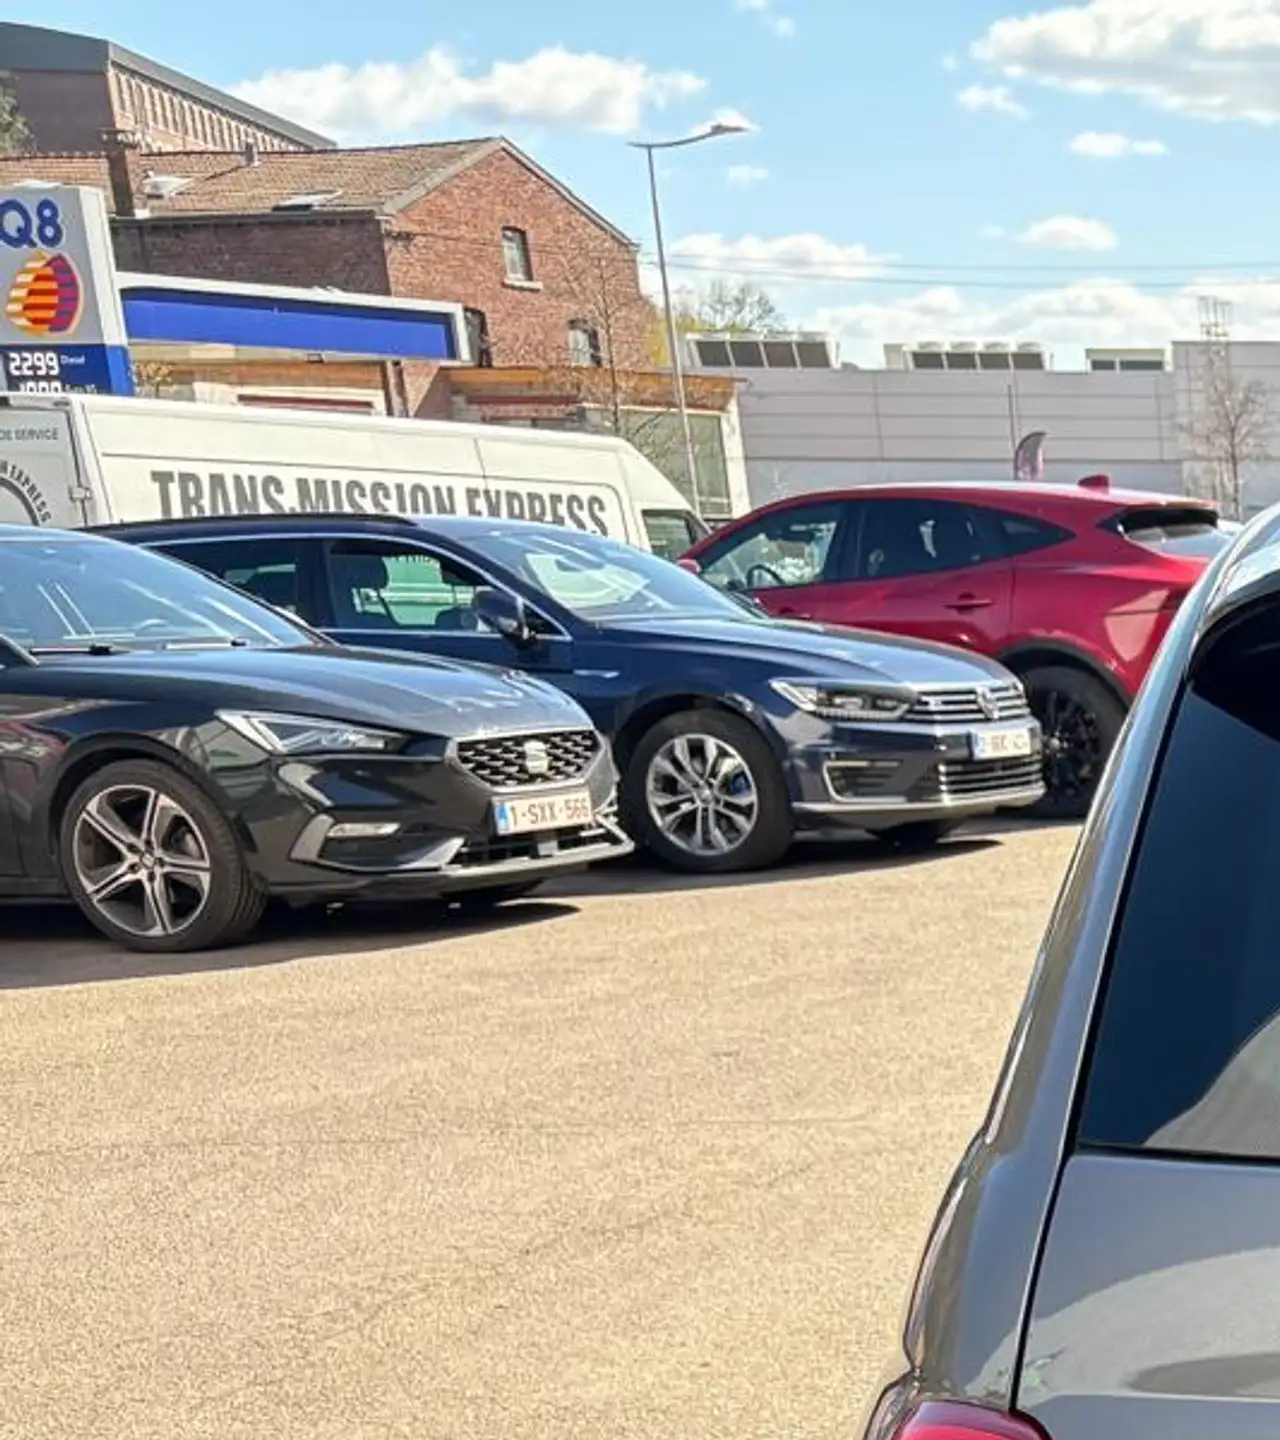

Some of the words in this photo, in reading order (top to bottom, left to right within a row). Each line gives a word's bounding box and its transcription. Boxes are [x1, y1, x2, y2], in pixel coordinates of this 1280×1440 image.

[0, 199, 63, 248] Q8
[9, 352, 59, 376] 2299
[465, 487, 608, 538] EXPRESS
